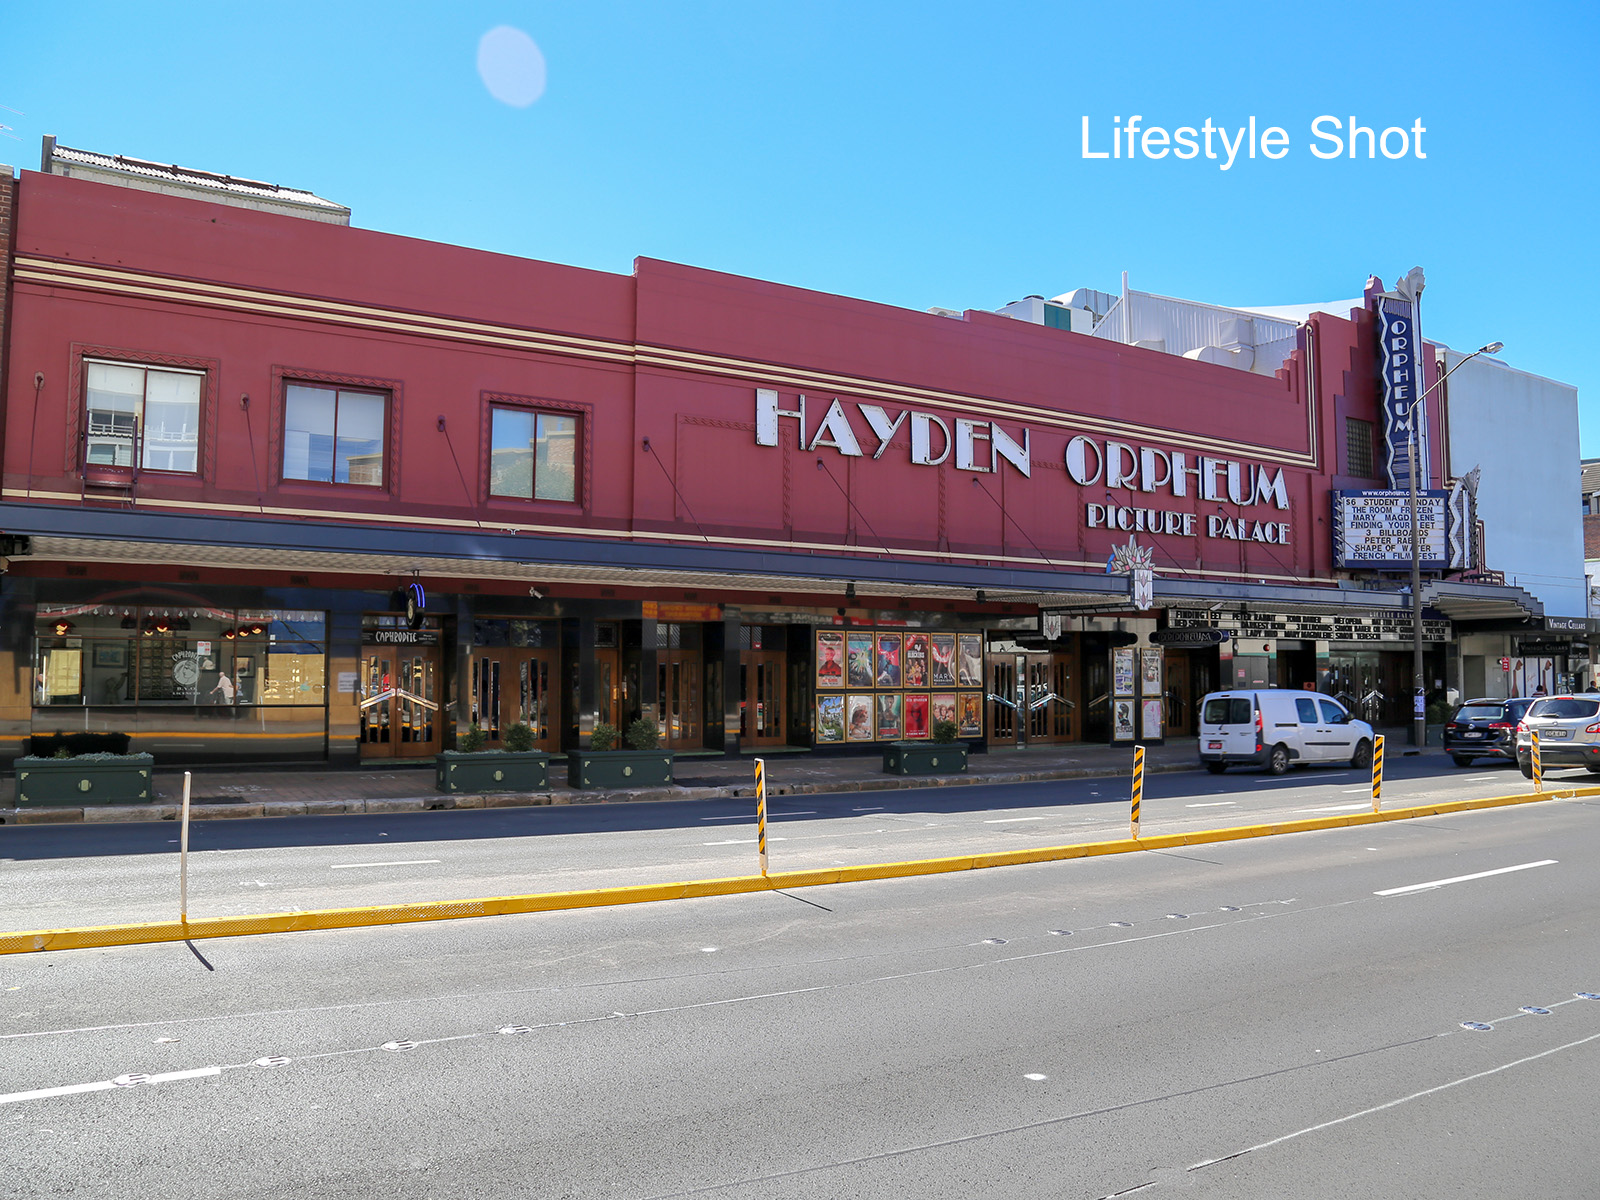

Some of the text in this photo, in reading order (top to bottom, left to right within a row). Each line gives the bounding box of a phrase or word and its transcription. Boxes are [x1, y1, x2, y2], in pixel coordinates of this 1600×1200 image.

[1390, 320, 1415, 433] ORPHEUM
[755, 387, 1291, 511] HAYDEN ORPHEUM
[1361, 489, 1428, 497] www.orpheum.cm.au
[1363, 498, 1399, 506] STUDENT
[1403, 498, 1441, 506] MNDAY
[1352, 506, 1433, 514] THE ROOM FRZEN
[1086, 503, 1292, 546] PICTURE PALACE
[1350, 521, 1436, 529] FINDING YOUR EET
[1379, 529, 1429, 537] BILLBOADS
[1355, 544, 1382, 552] SHAPE
[1385, 544, 1396, 552] OF
[1352, 552, 1386, 560] FRENCH
[1392, 552, 1412, 560] FILM
